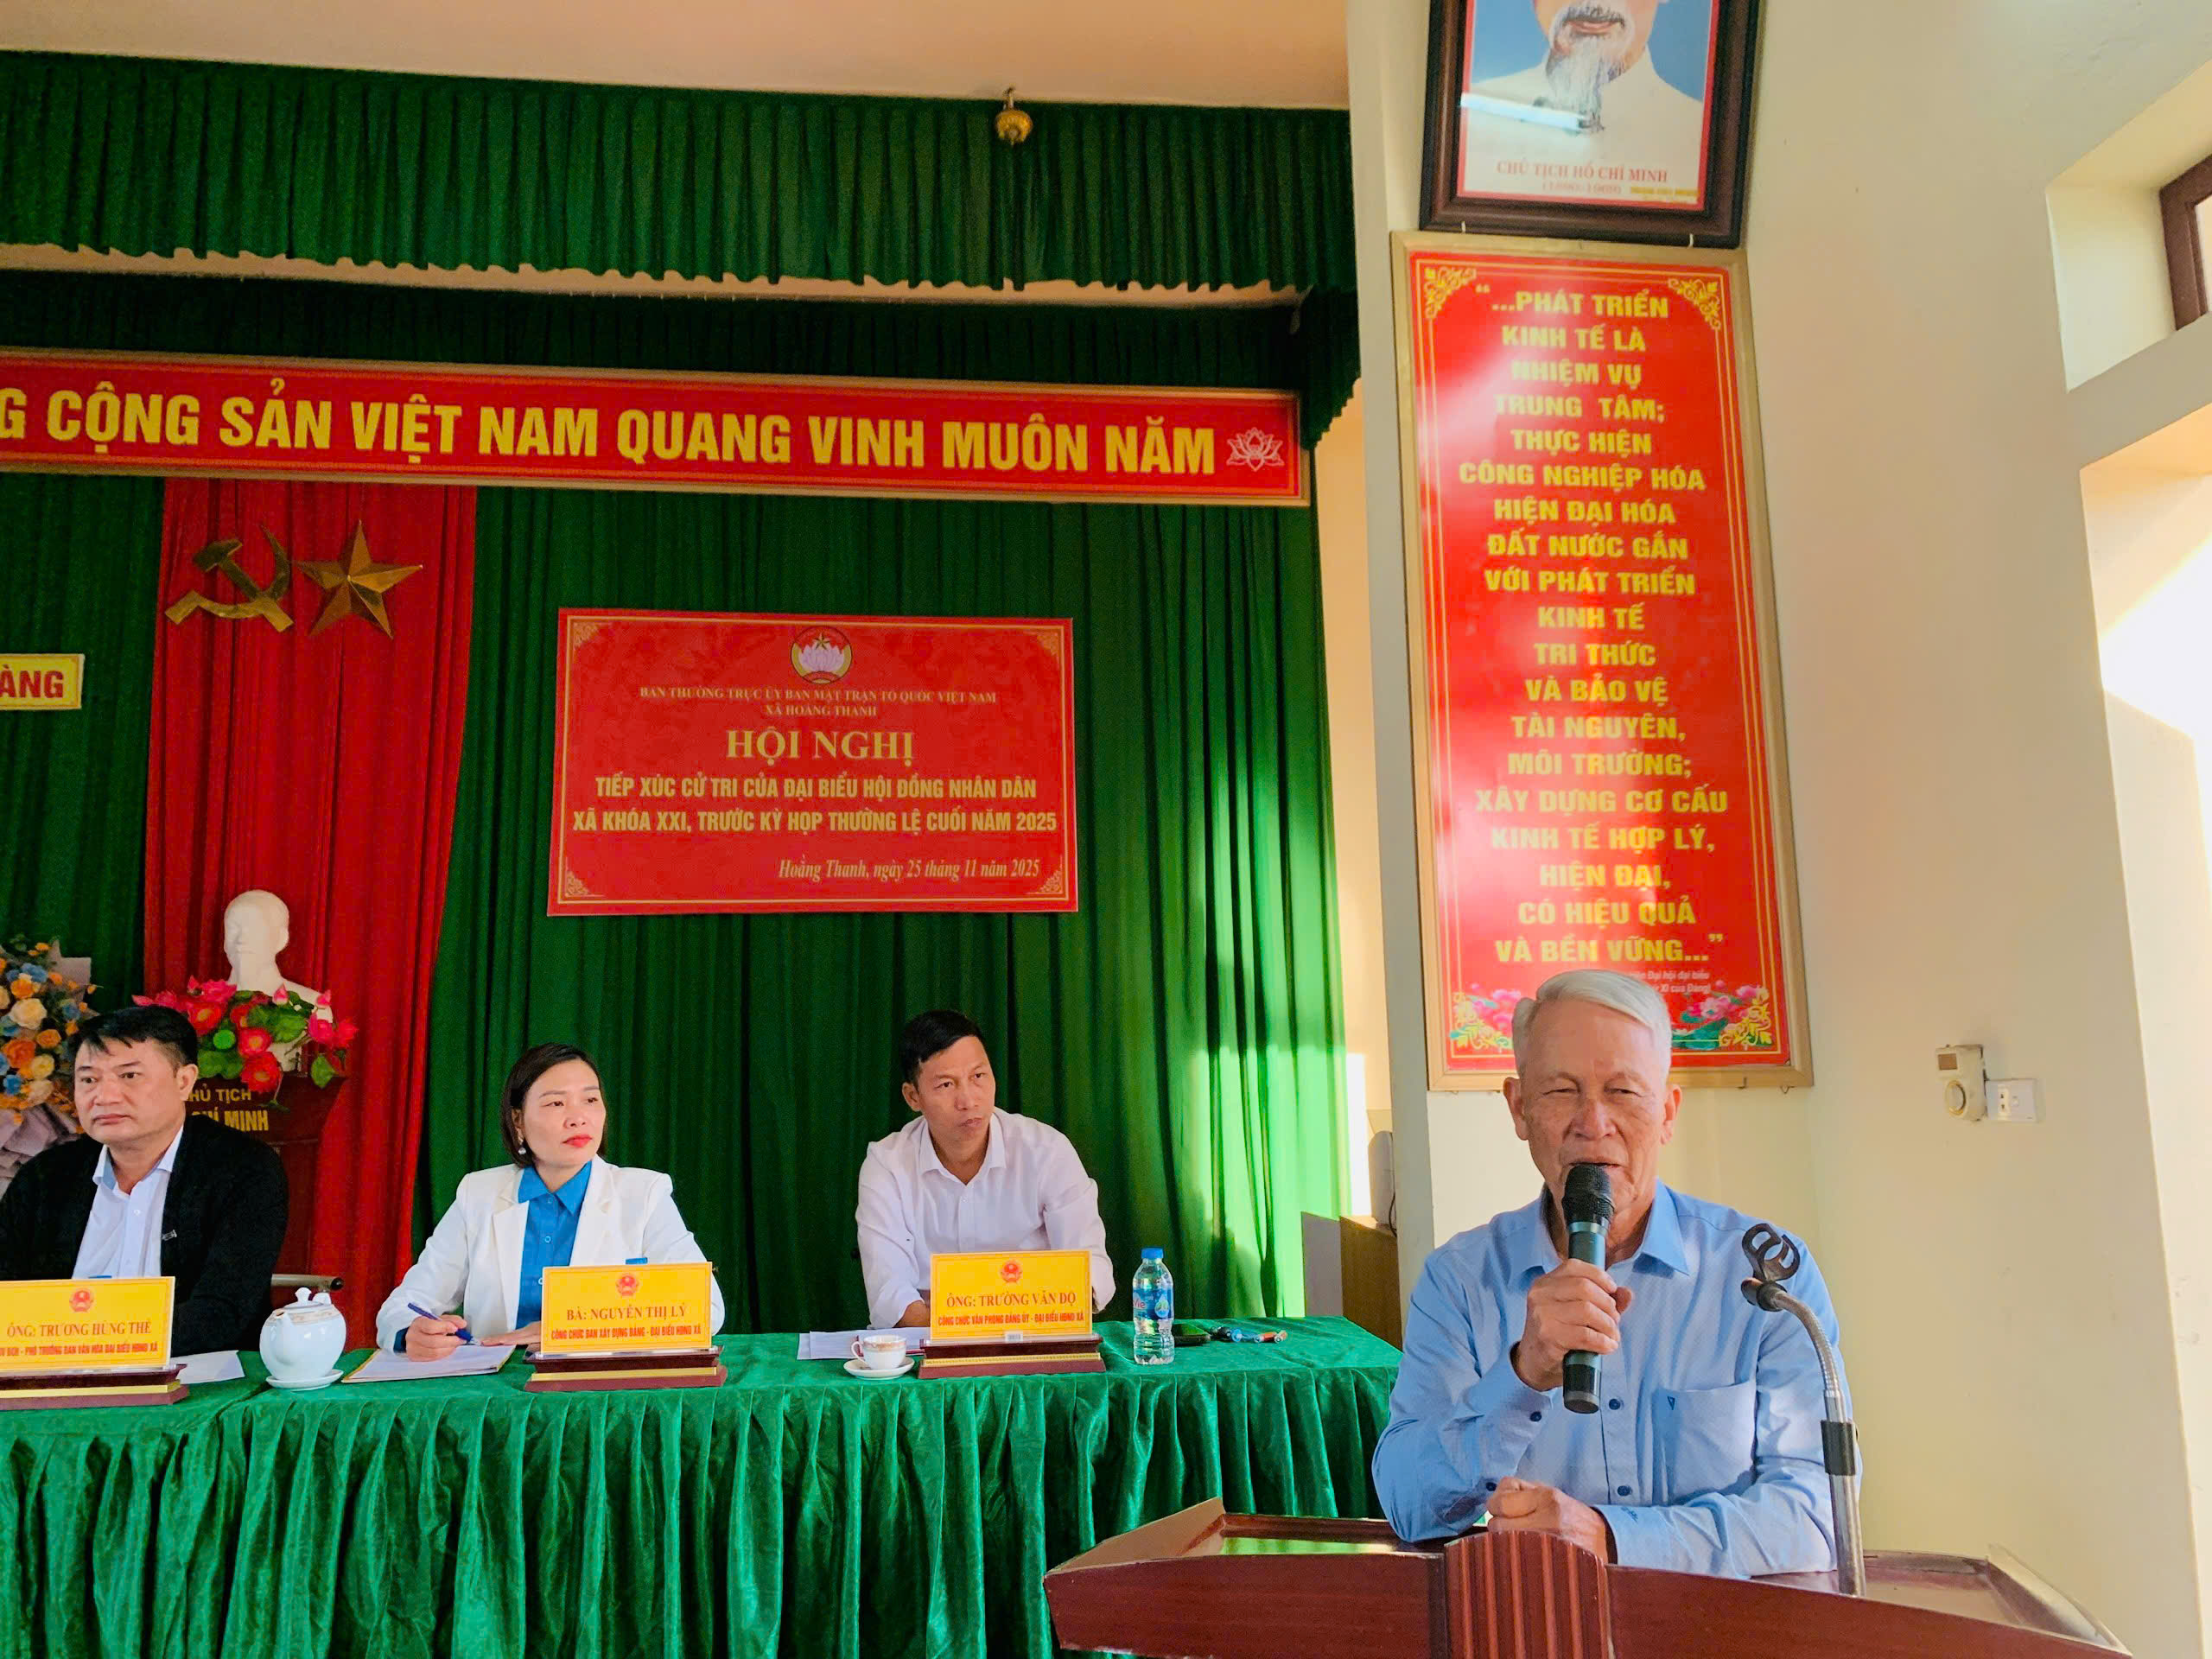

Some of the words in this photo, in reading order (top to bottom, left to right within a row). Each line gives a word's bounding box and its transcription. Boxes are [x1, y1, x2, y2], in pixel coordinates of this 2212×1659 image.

[1628, 169, 1668, 182] MINH
[1591, 289, 1669, 318] TRIỂN
[1502, 325, 1567, 347] KINH
[1574, 322, 1605, 351] TẾ
[1614, 325, 1646, 352] LÀ
[1511, 358, 1599, 386] NHIỆM
[1607, 364, 1642, 390] VỤ
[1494, 394, 1582, 417] TRUNG
[47, 380, 200, 454] CỘNG
[219, 377, 333, 449] SẢN
[351, 393, 462, 464] VIỆT
[478, 406, 599, 457] NAM
[616, 408, 791, 465] QUANG
[808, 415, 925, 469] VINH
[941, 411, 1089, 473] MUÔN
[1104, 415, 1215, 475] NĂM
[1510, 429, 1580, 456] THỰC
[1589, 430, 1652, 458] HIỆN
[1459, 460, 1534, 485] CÔNG
[1543, 463, 1643, 493] NGHIỆP
[1651, 465, 1707, 491] HÓA
[1494, 496, 1559, 524] HIỆN
[1567, 500, 1613, 527] ĐẠI
[1621, 500, 1676, 524] HÓA
[1487, 527, 1541, 556] ĐẤT
[1549, 532, 1624, 558] NƯỚC
[1632, 530, 1688, 559] GẮN
[1484, 566, 1529, 591] VỚI
[1538, 567, 1608, 593] PHÁT
[1617, 564, 1695, 594] TRIỂN
[1538, 607, 1605, 629] KINH
[1614, 601, 1645, 630] TẾ
[1535, 642, 1575, 665] TRI
[1585, 639, 1656, 666] THỨC
[639, 687, 665, 698] BAN
[785, 690, 810, 699] BAN
[969, 691, 996, 703] NAM
[1525, 676, 1561, 702] VÀ
[1570, 673, 1627, 702] BẢO
[1637, 677, 1669, 707] VỆ
[835, 705, 877, 716] THANH
[1511, 713, 1554, 739] TÀI
[1565, 714, 1687, 742] NGUYÊN,
[726, 726, 800, 766] HỘI
[812, 730, 913, 767] NGHỊ
[1509, 749, 1562, 775] MÔI
[595, 771, 634, 797] TIẾP
[639, 774, 676, 798] XÚC
[681, 771, 708, 798] CỬ
[711, 778, 737, 798] TRI
[743, 772, 778, 798] CỦA
[783, 778, 813, 802] ĐẠI
[818, 771, 858, 798] BIỂU
[863, 775, 892, 802] HỘI
[897, 772, 944, 798] ĐỒNG
[949, 777, 996, 798] NHÂN
[1001, 777, 1037, 798] DÂN
[1476, 785, 1529, 812] XÂY
[1539, 788, 1616, 817] DỰNG
[1624, 788, 1662, 812] CƠ
[1672, 784, 1727, 812] CẤU
[573, 807, 597, 831] XÃ
[602, 807, 651, 831] KHÓA
[657, 810, 691, 834] XXI,
[697, 808, 754, 831] TRƯỚC
[760, 808, 782, 831] KỲ
[787, 811, 823, 836] HỌP
[828, 807, 897, 831] THƯỜNG
[901, 808, 921, 836] LỆ
[926, 804, 967, 831] CUỐI
[971, 809, 1012, 831] NĂM
[1015, 812, 1058, 832] 2025
[1492, 827, 1559, 849] KINH
[1568, 821, 1599, 849] TẾ
[1610, 826, 1666, 855] HỢP
[1674, 823, 1715, 853] LÝ,
[825, 860, 870, 880] Thanh,
[873, 860, 904, 882] ngày
[906, 860, 921, 878] 25
[925, 860, 962, 883] tháng
[964, 860, 978, 877] 11
[980, 861, 1007, 877] năm
[1010, 859, 1041, 877] 2025
[1540, 861, 1606, 891] HIỆN
[1615, 864, 1671, 892] ĐẠI,
[1519, 898, 1555, 925] CÓ
[1566, 899, 1629, 930] HIỆU
[1638, 895, 1695, 927] QUẢ
[1495, 937, 1532, 962] VÀ
[1541, 930, 1598, 962] BỀN
[187, 1083, 211, 1102] HỦ
[215, 1088, 251, 1104] TỊCH
[225, 1109, 269, 1132] MINH
[647, 1306, 667, 1320] THỊ
[671, 1303, 686, 1318] LÝ
[1033, 1290, 1056, 1305] VĂN
